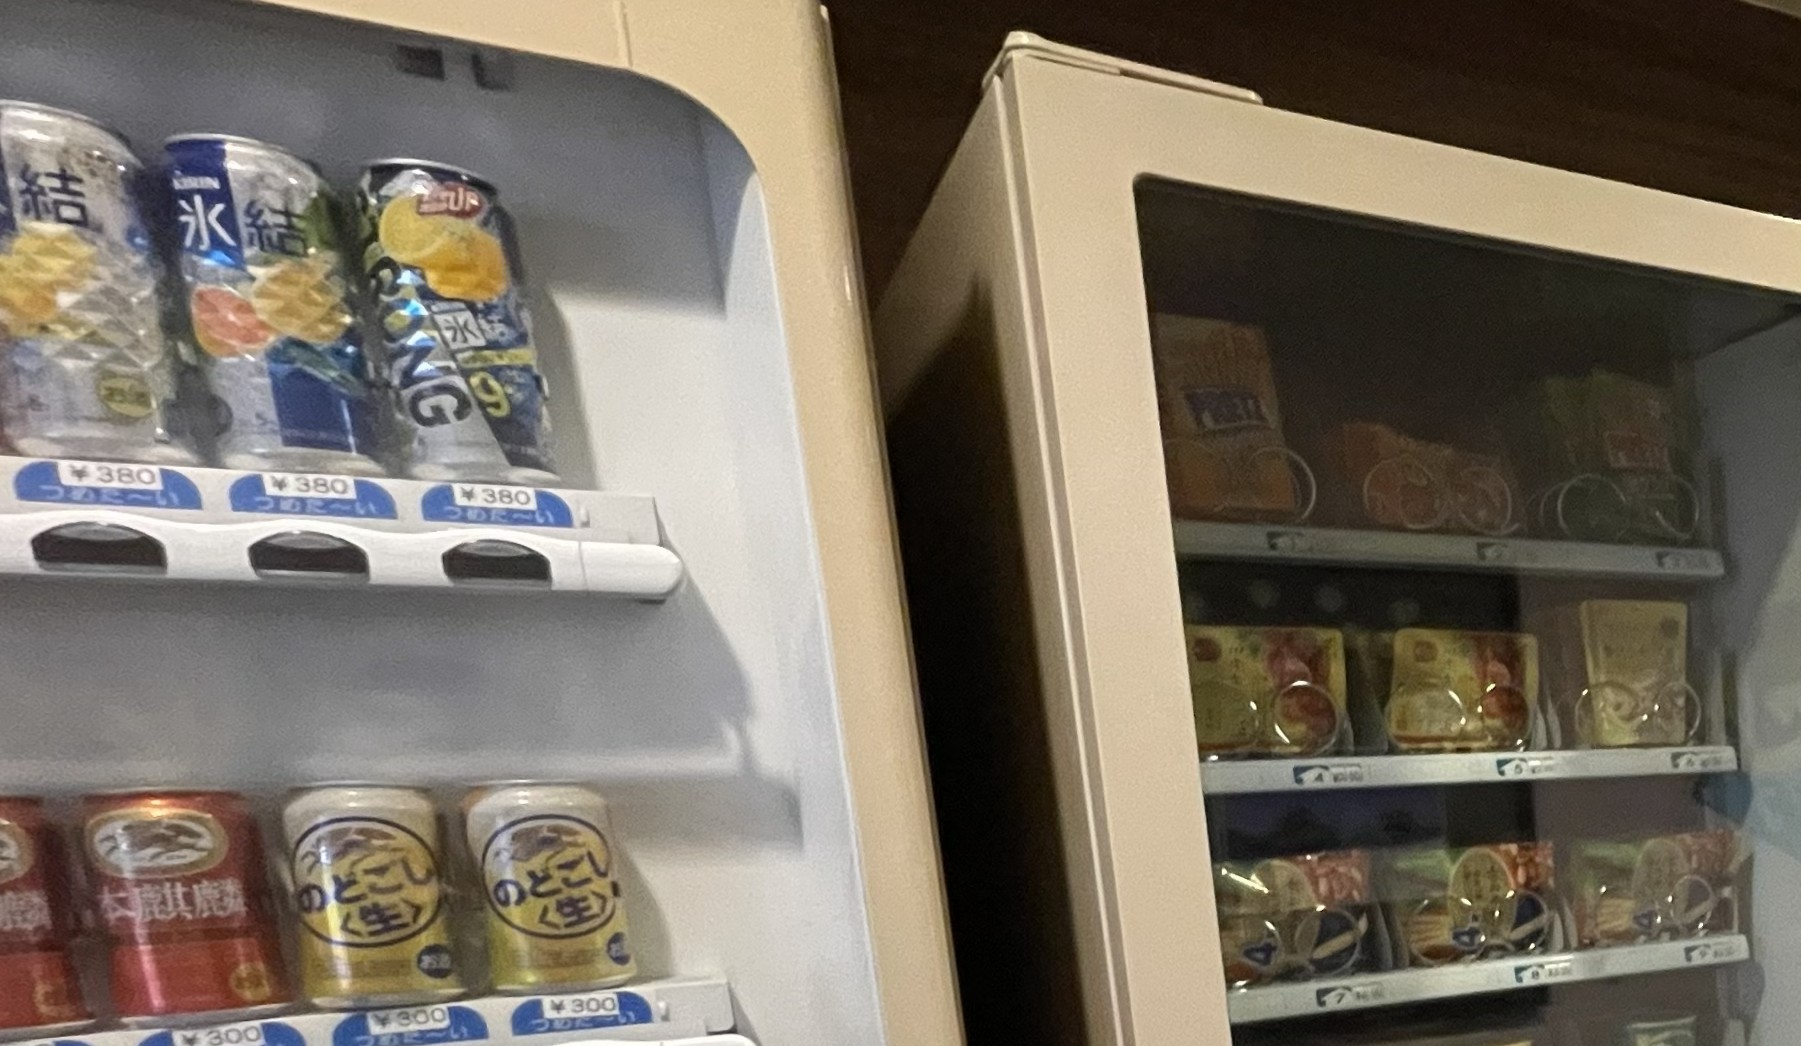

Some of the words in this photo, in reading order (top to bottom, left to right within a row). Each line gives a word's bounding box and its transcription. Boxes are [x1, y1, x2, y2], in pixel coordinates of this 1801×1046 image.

[69, 464, 156, 485] ¥380
[270, 475, 348, 495] ¥380
[460, 485, 531, 506] ¥380
[550, 996, 619, 1014] ¥300
[371, 1007, 447, 1030] ¥300
